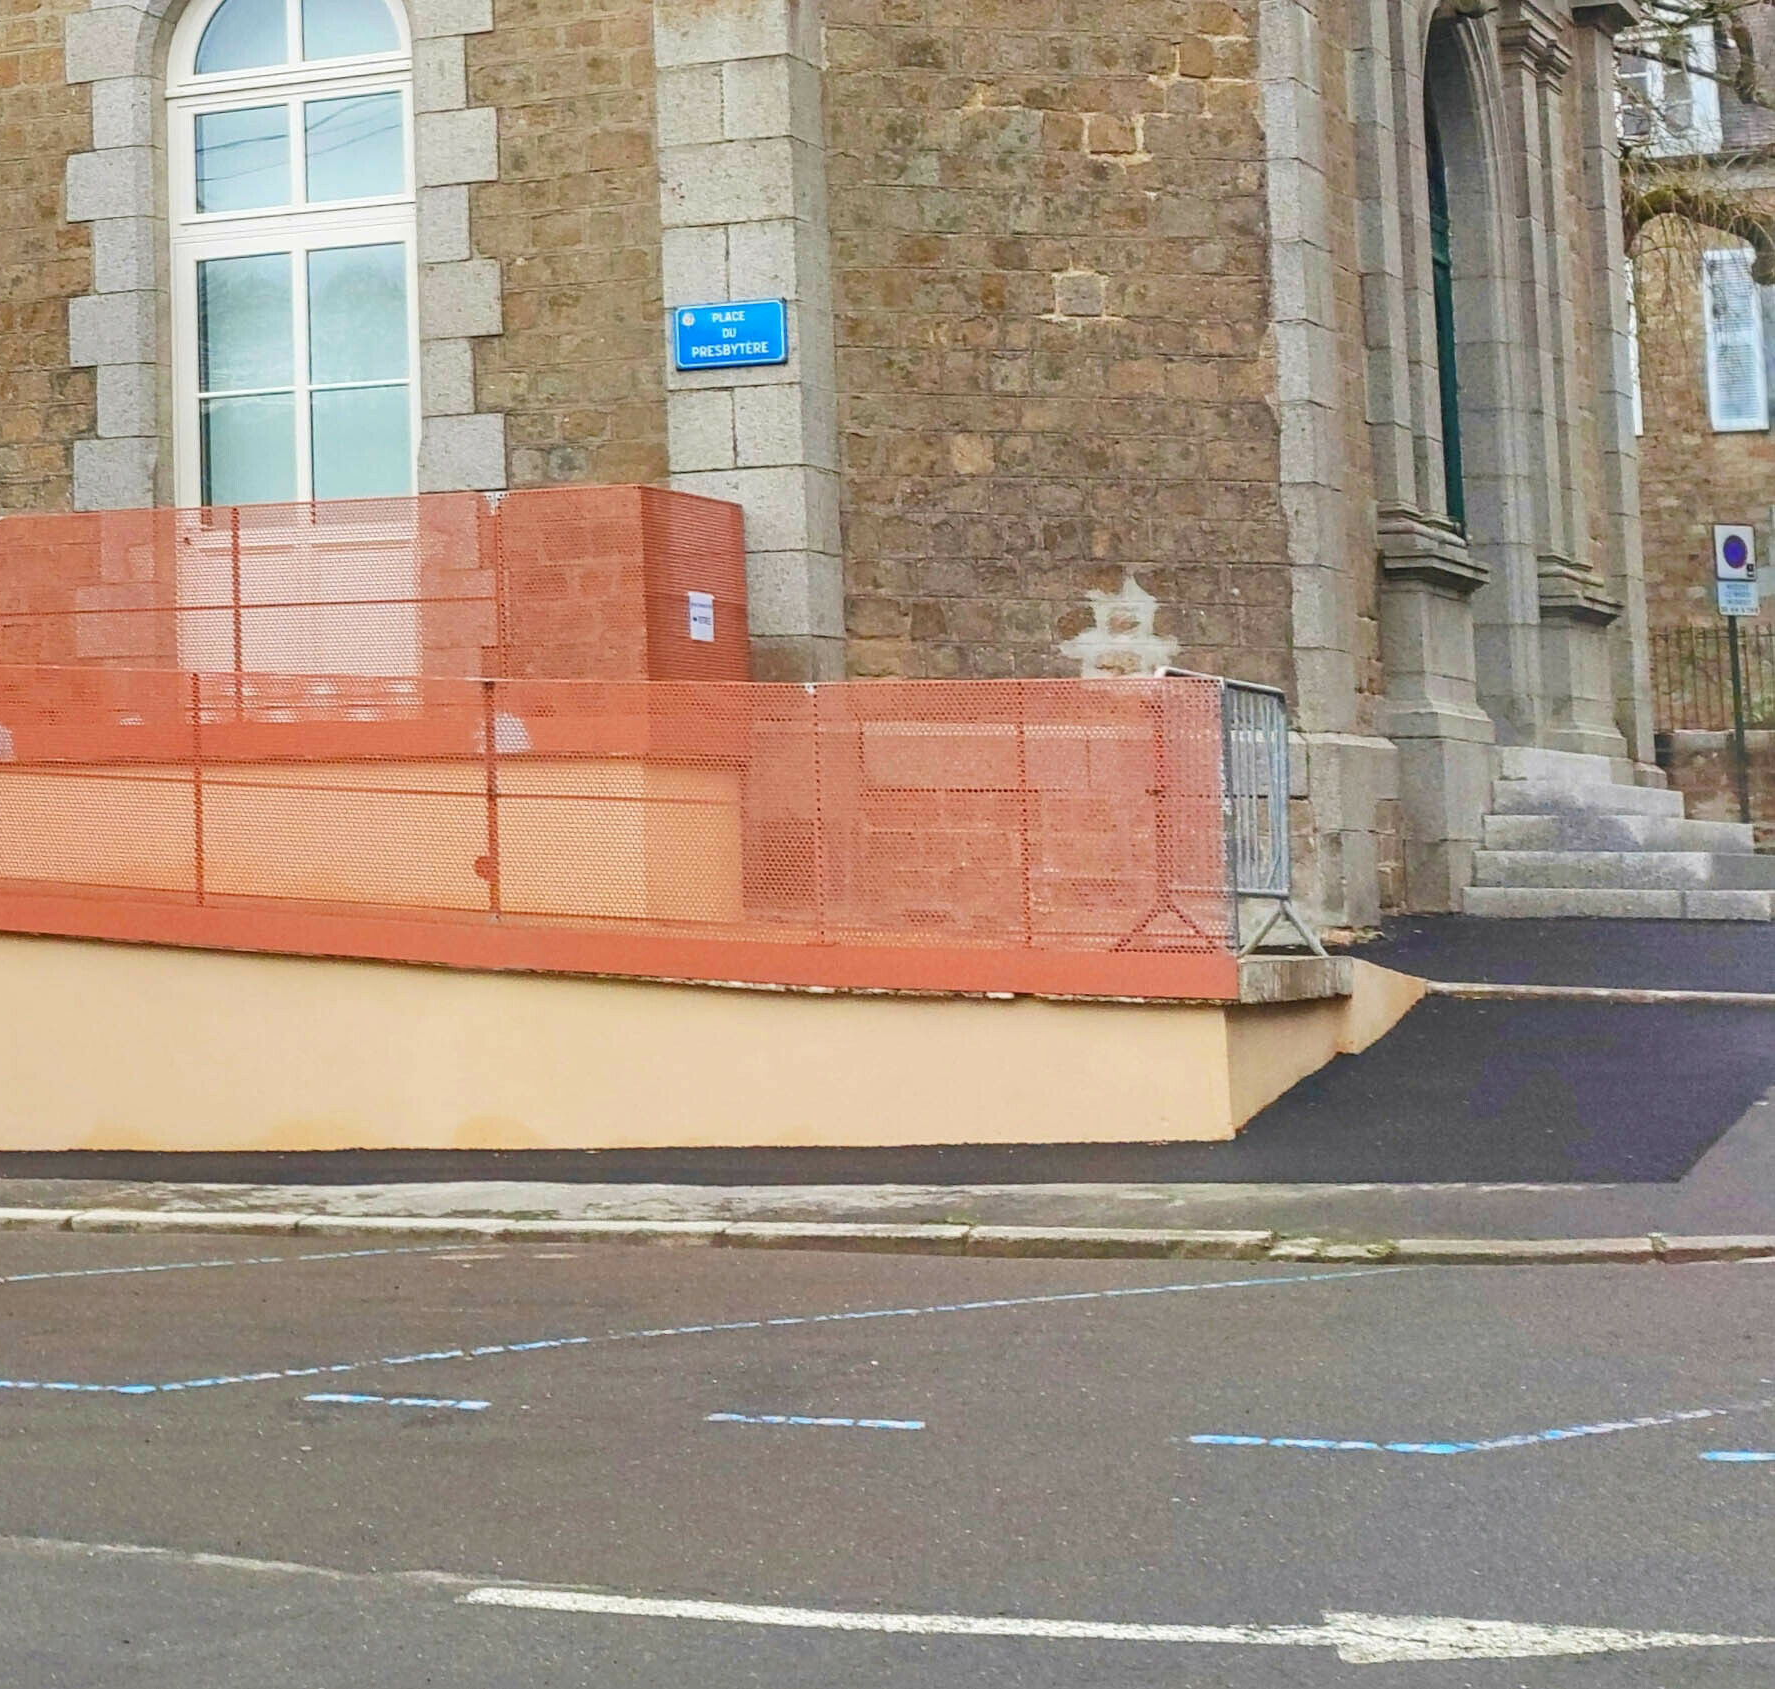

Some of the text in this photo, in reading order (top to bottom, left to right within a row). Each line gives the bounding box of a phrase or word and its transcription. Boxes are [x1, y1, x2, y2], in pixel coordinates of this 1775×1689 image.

[712, 312, 745, 323] PLACE
[722, 328, 737, 338] DU
[691, 341, 769, 358] PRESBYTÈRE
